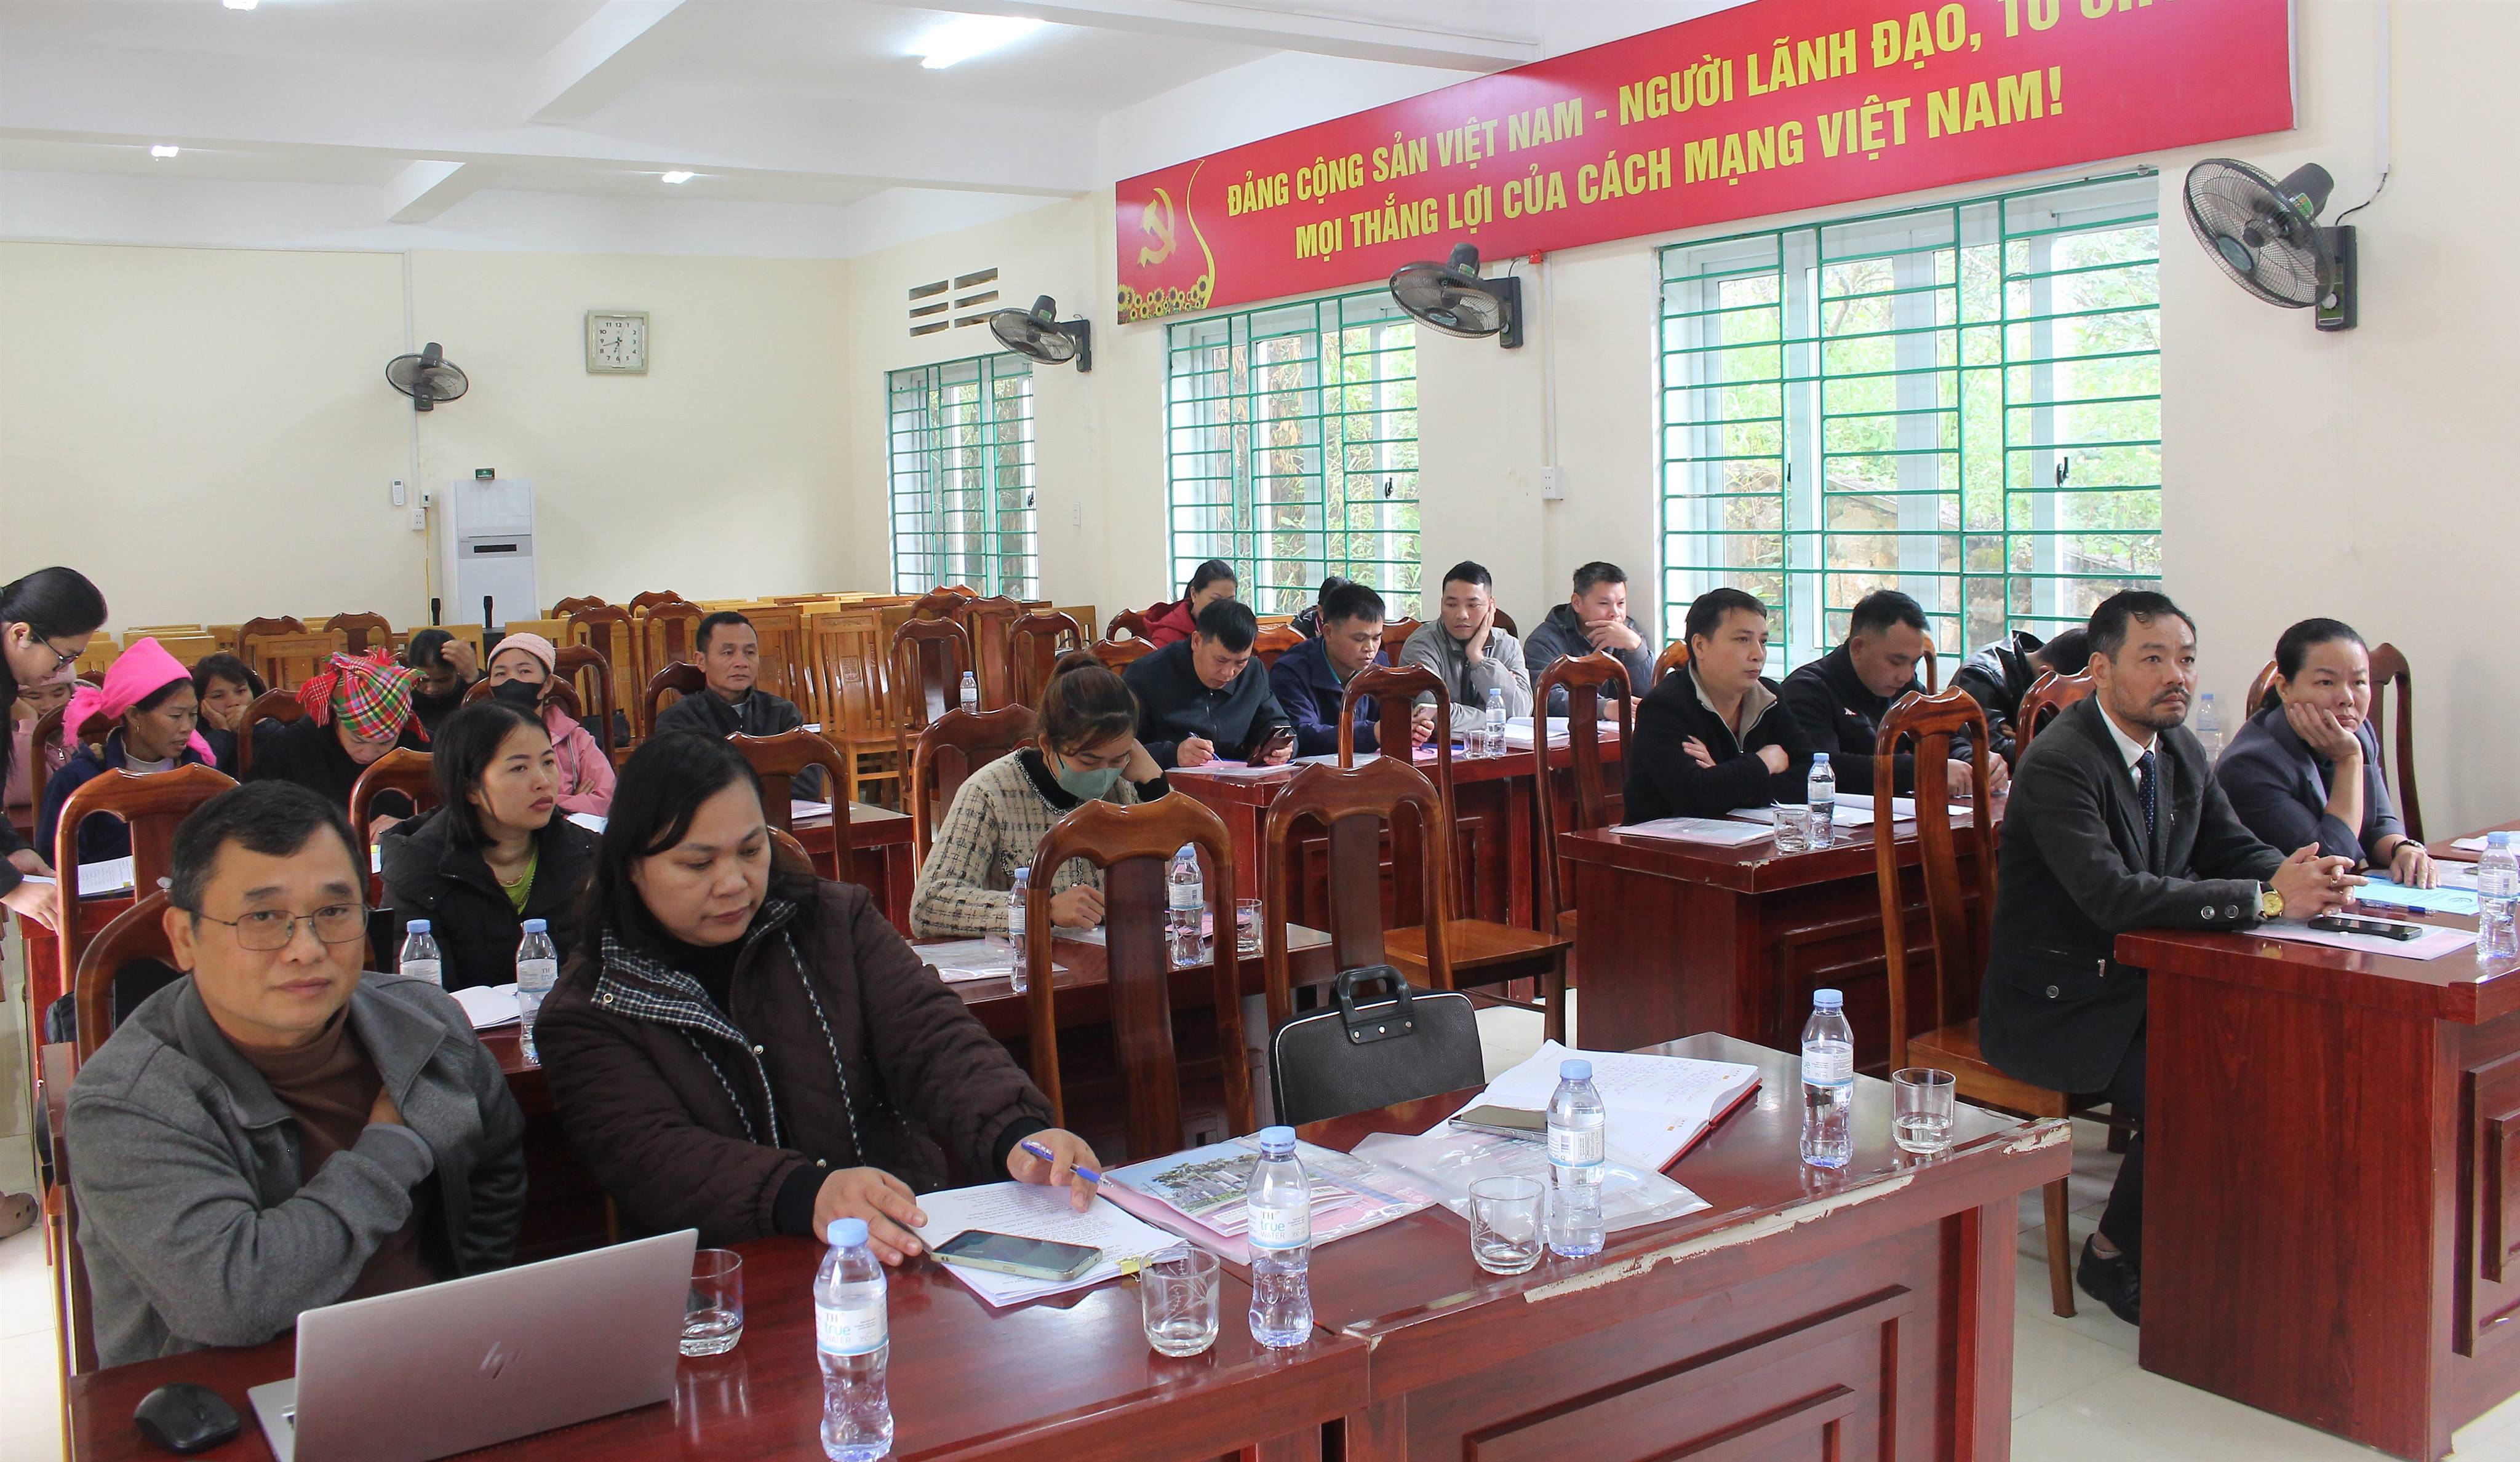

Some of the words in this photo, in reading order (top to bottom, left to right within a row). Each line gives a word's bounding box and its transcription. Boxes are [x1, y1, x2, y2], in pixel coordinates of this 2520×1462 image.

[1227, 170, 1290, 217] ĐẢNG
[1296, 153, 1365, 205] CỘNG
[1372, 132, 1429, 183] SẢN
[1437, 116, 1498, 170] VIỆT
[1507, 98, 1584, 150] NAM
[1618, 53, 1734, 125] NGƯỜI
[1747, 28, 1857, 97] LÃNH
[1870, 3, 1982, 70] ĐẠO,
[1296, 218, 1343, 262] MỌI
[1349, 193, 1439, 247] THẮNG
[1447, 185, 1494, 234] LỢI
[1502, 164, 1569, 219] CỦA
[1577, 147, 1672, 204] CÁCH
[1683, 121, 1805, 186] MẠNG
[1816, 94, 1912, 161] VIỆT
[1926, 66, 2063, 139] NAM!
[1261, 1220, 1285, 1231] true
[1261, 1231, 1285, 1239] WATER
[824, 1322, 850, 1336] true
[826, 1335, 851, 1344] WATER
